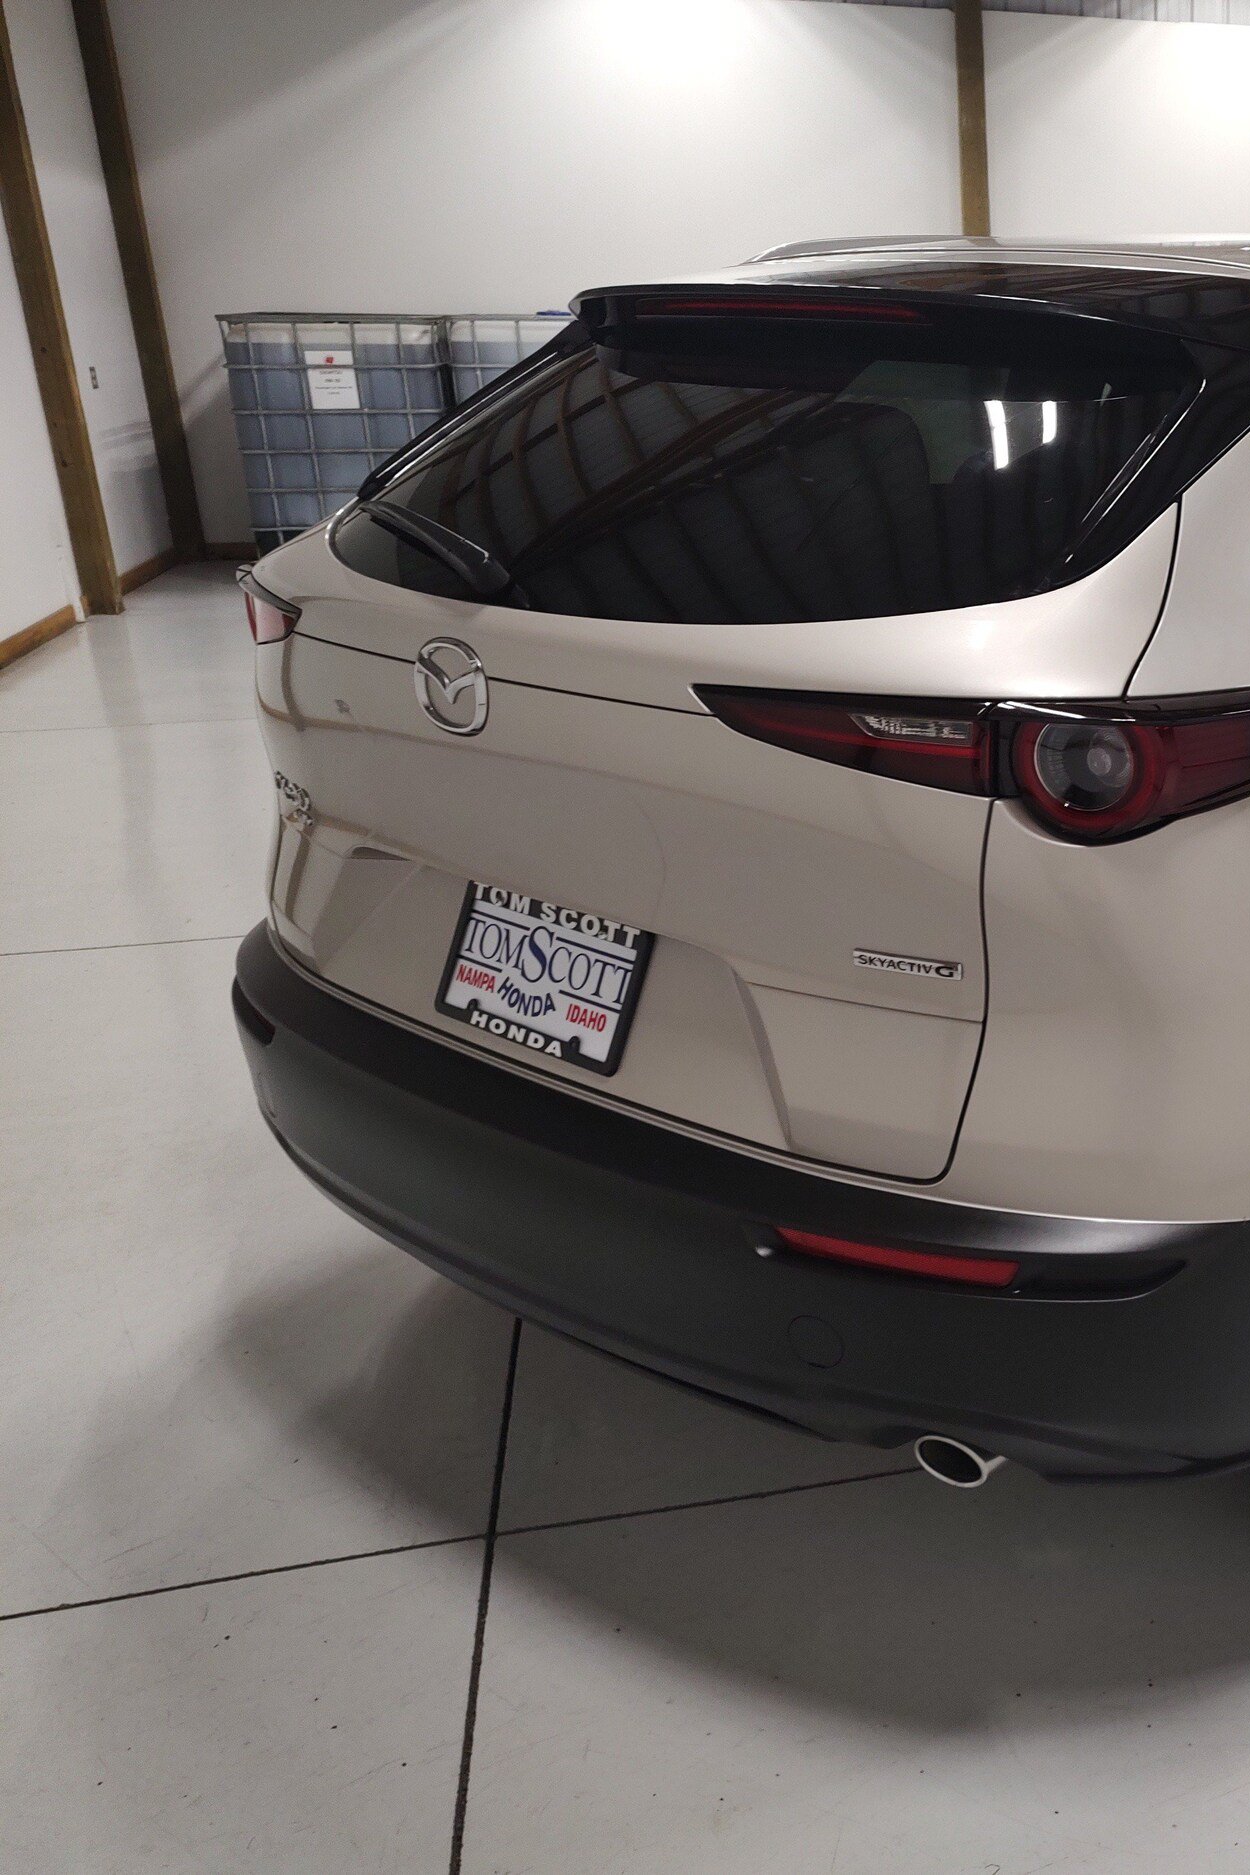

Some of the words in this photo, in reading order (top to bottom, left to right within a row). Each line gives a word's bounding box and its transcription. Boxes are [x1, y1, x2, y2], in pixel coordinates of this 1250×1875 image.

[474, 882, 531, 915] TOM
[540, 902, 640, 947] SCOTT
[456, 965, 496, 992] NAMPA
[497, 977, 556, 1017] HONDA
[566, 1003, 607, 1032] IDAHO
[470, 1011, 562, 1057] HONDA
